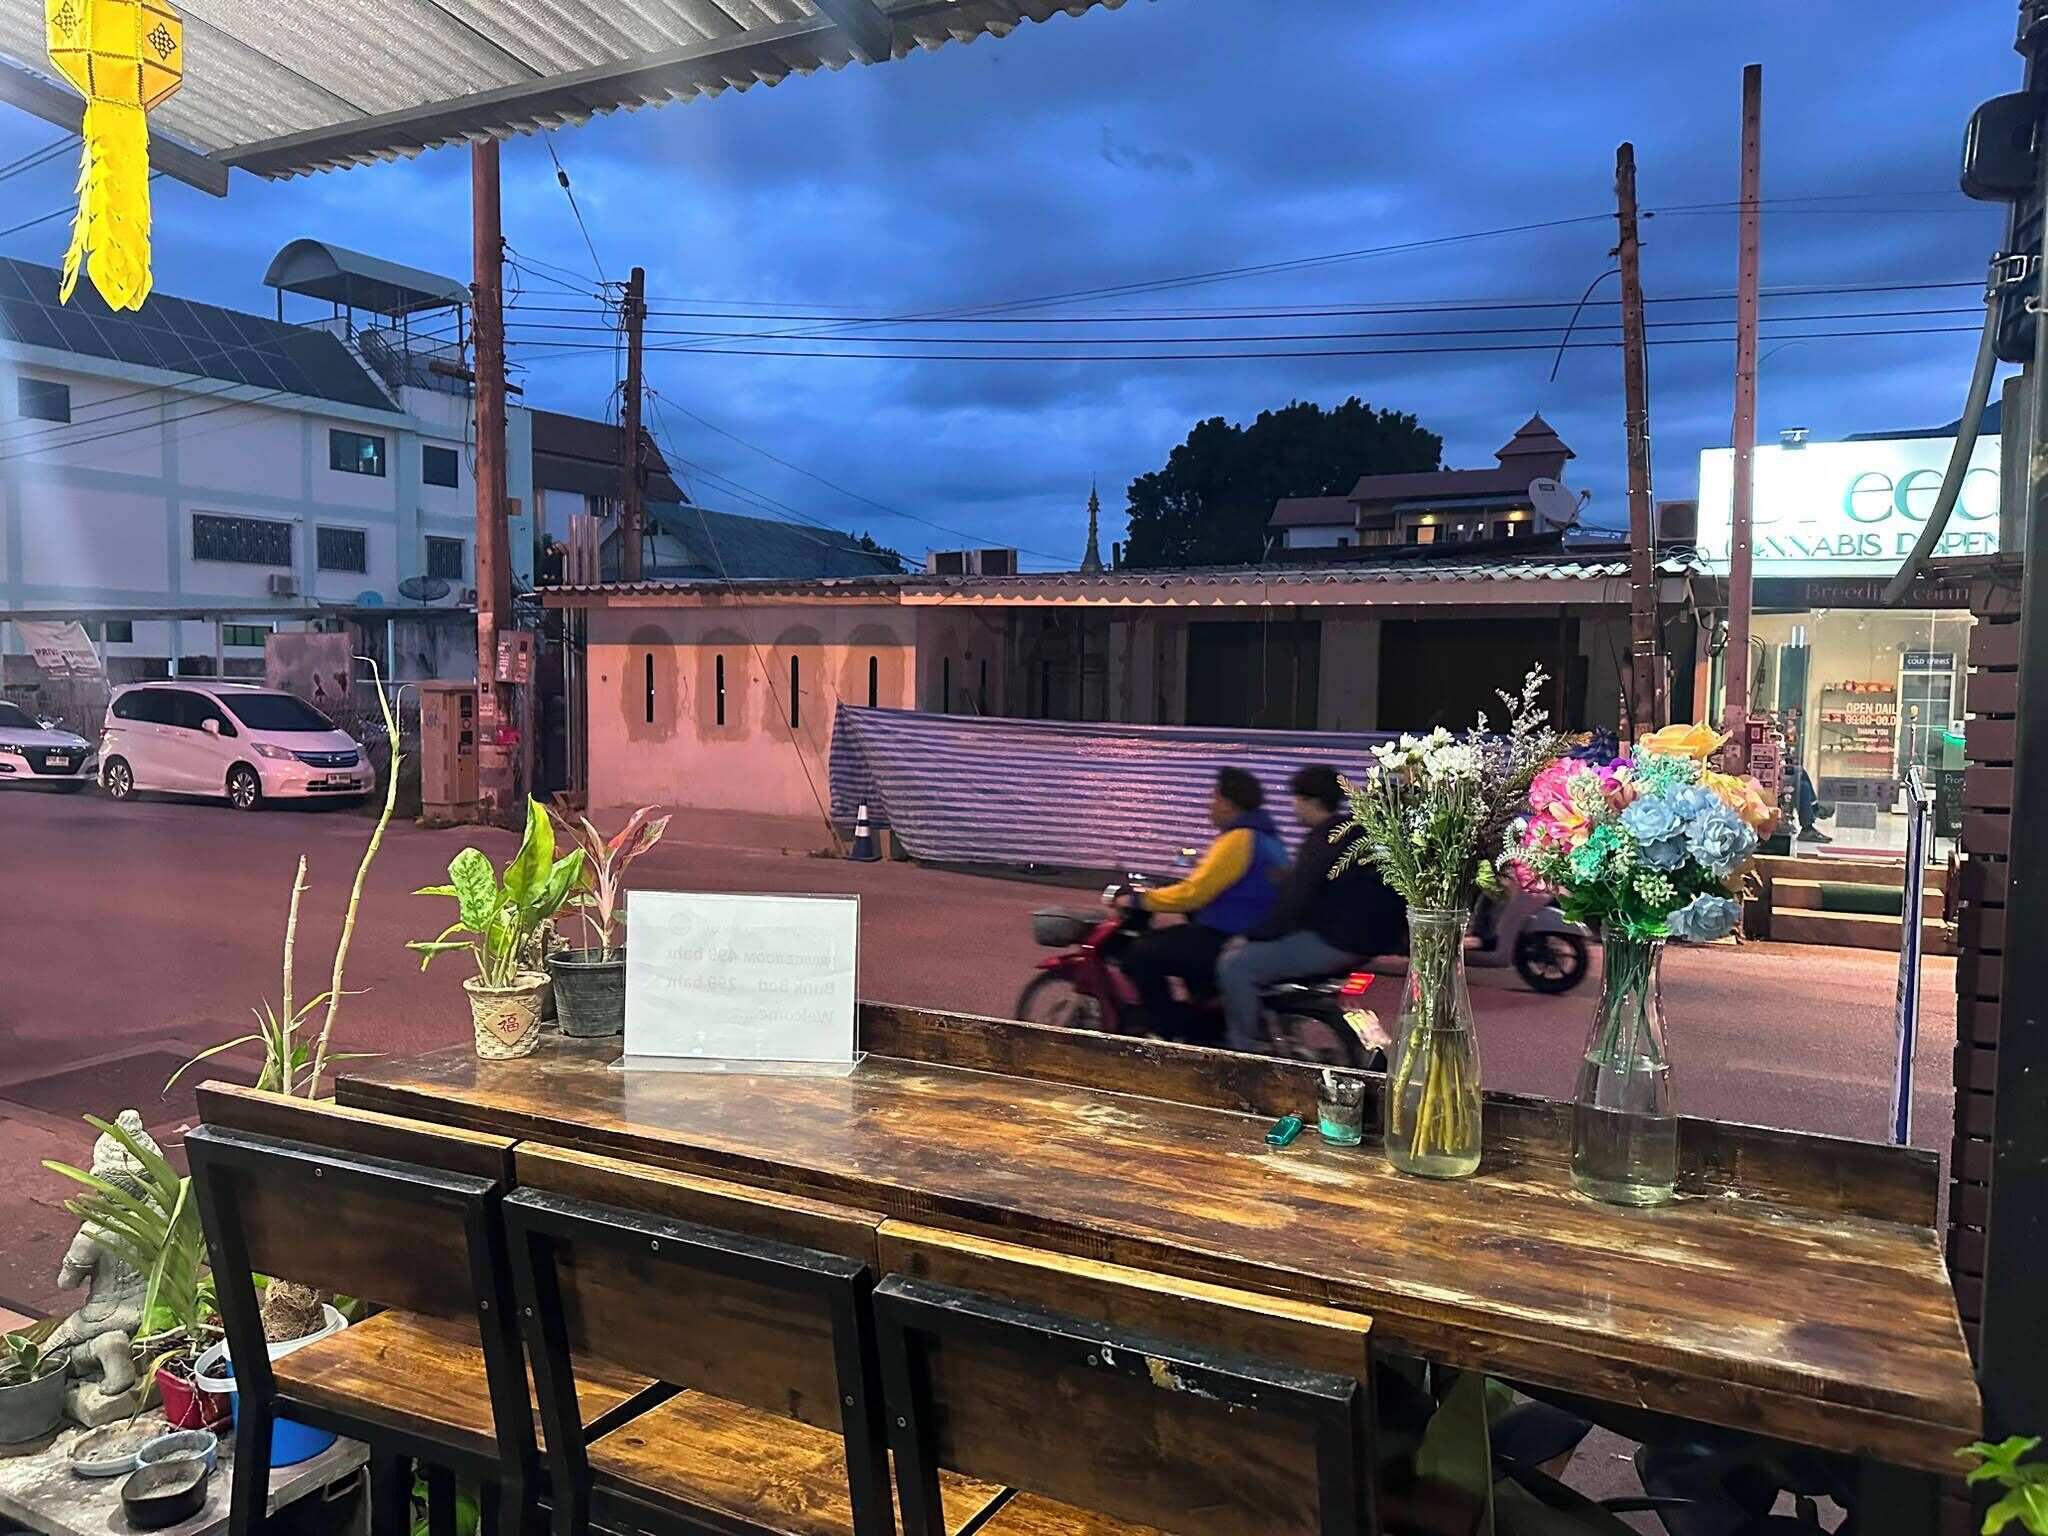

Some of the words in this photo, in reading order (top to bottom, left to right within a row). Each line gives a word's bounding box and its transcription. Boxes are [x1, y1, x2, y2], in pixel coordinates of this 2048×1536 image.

[1725, 533, 1882, 558] NNABIS
[1805, 582, 1907, 606] Breedi
[1846, 702, 1874, 715] OPEN
[497, 1013, 519, 1033] 福
